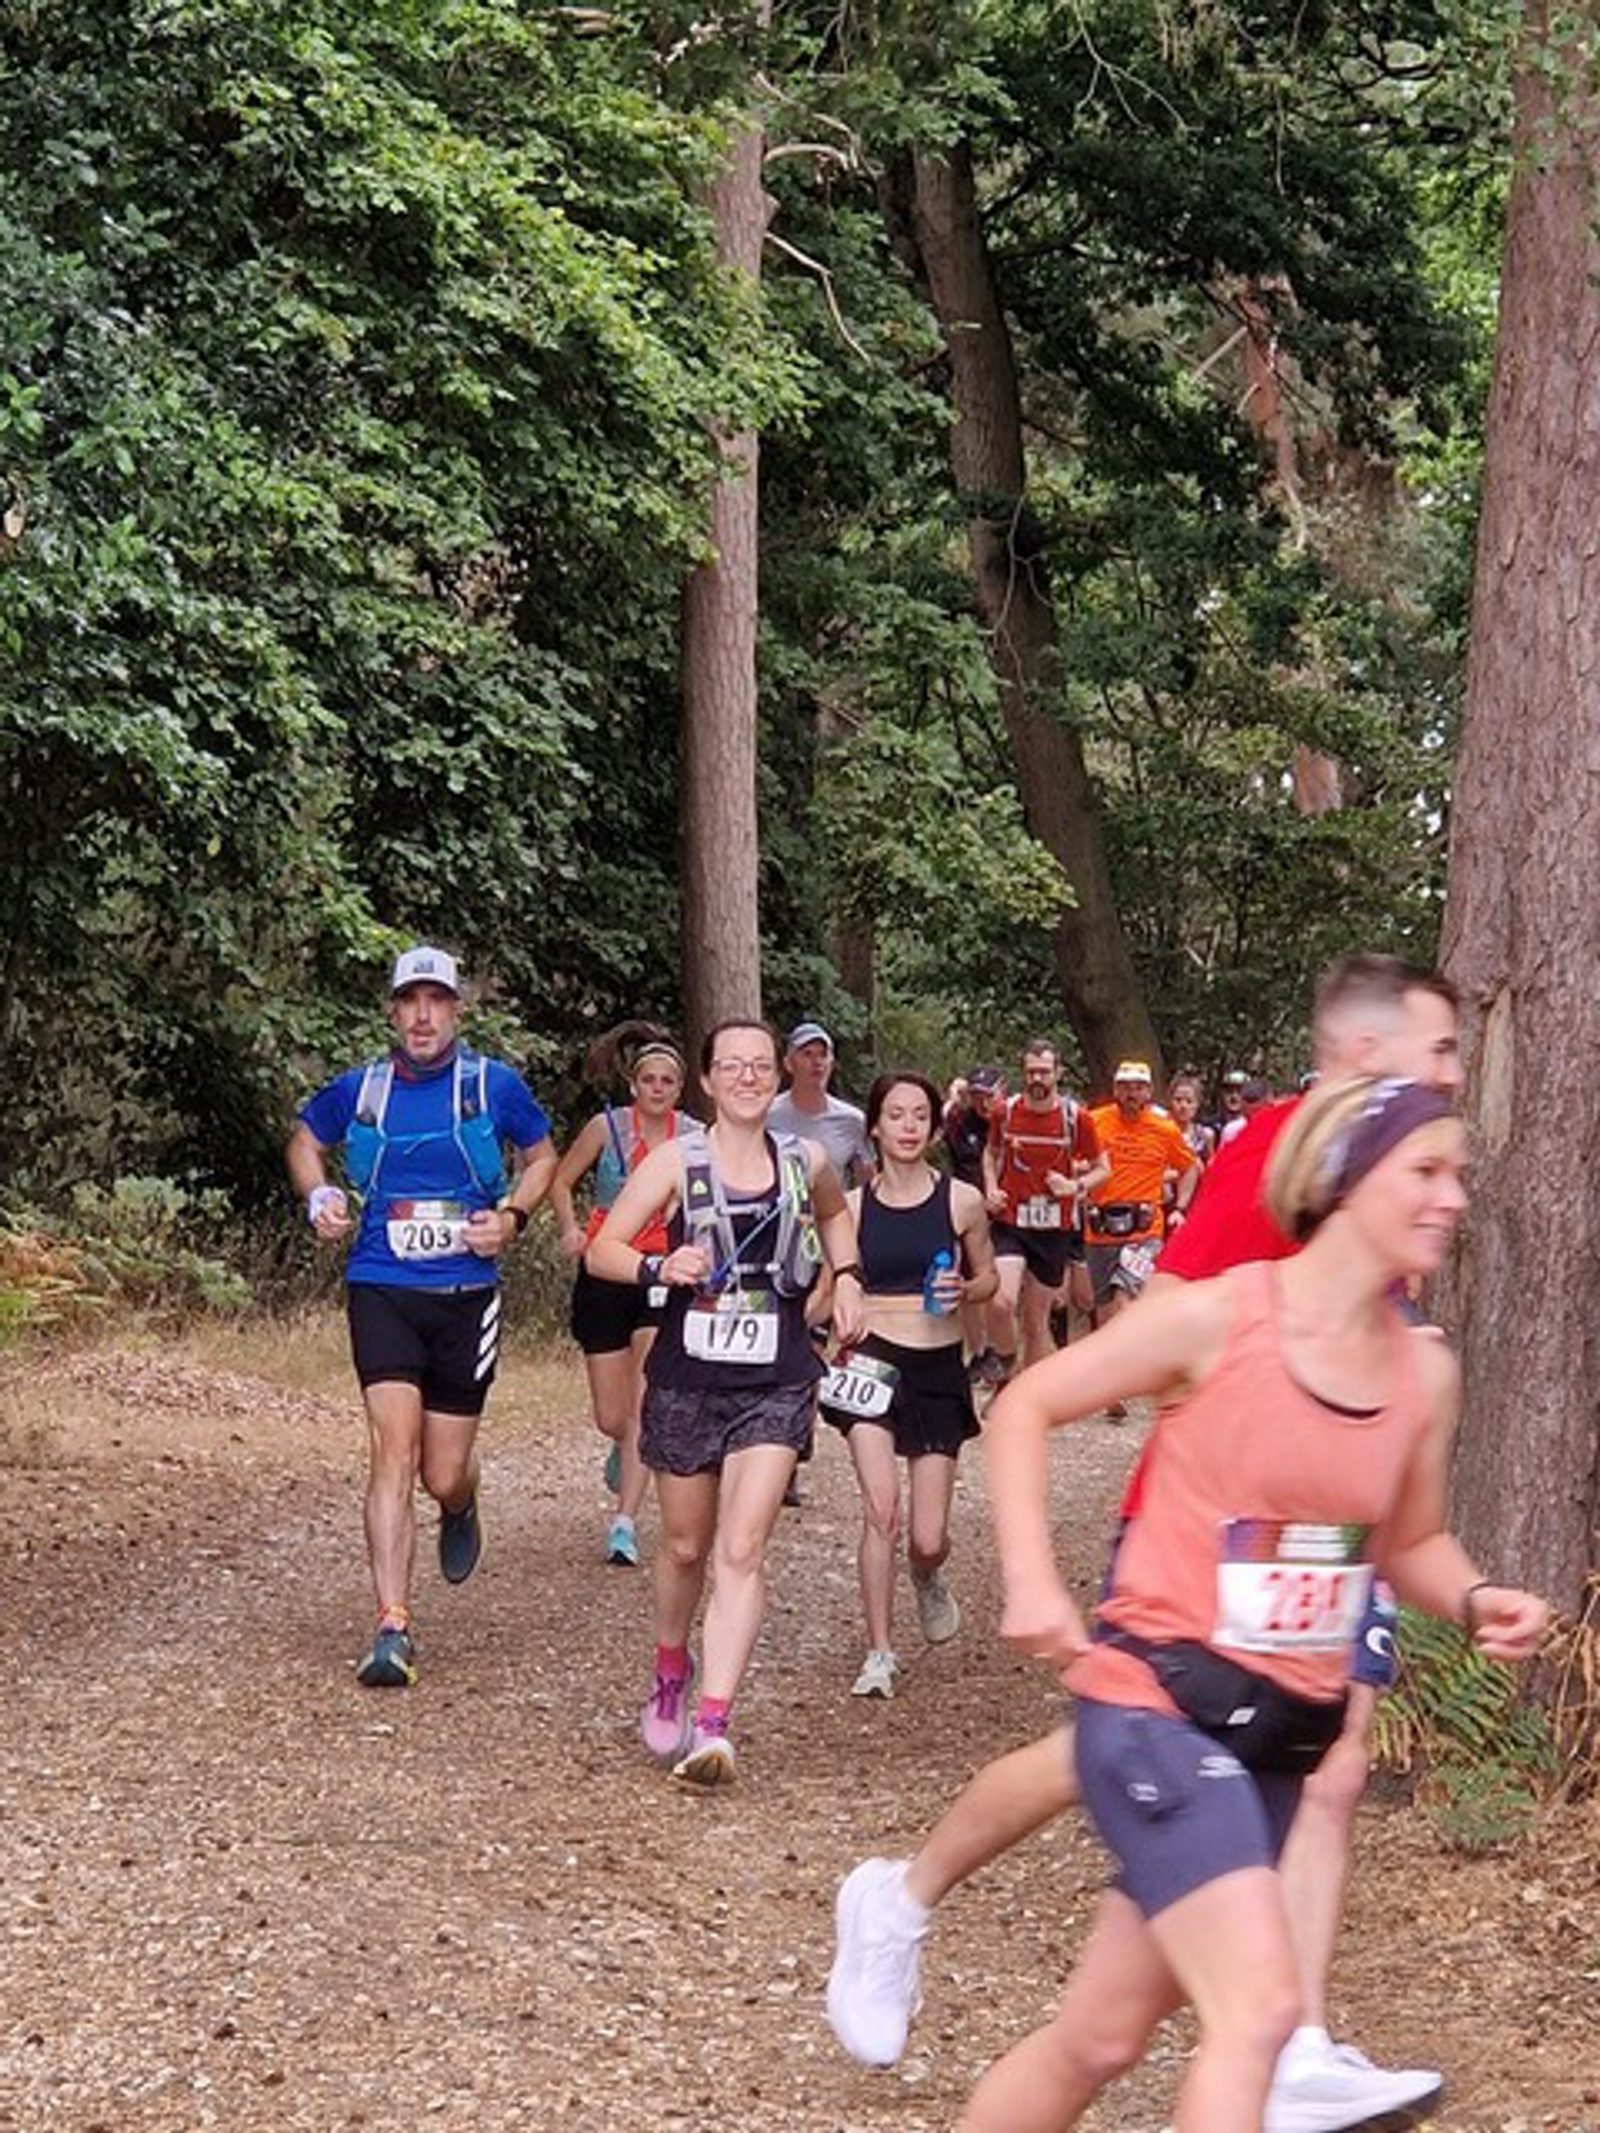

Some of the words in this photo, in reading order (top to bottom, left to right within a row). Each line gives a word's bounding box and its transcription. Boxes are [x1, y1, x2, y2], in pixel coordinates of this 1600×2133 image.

[403, 1223, 452, 1251] 203
[708, 1318, 758, 1350] 179
[832, 1372, 876, 1405] 210
